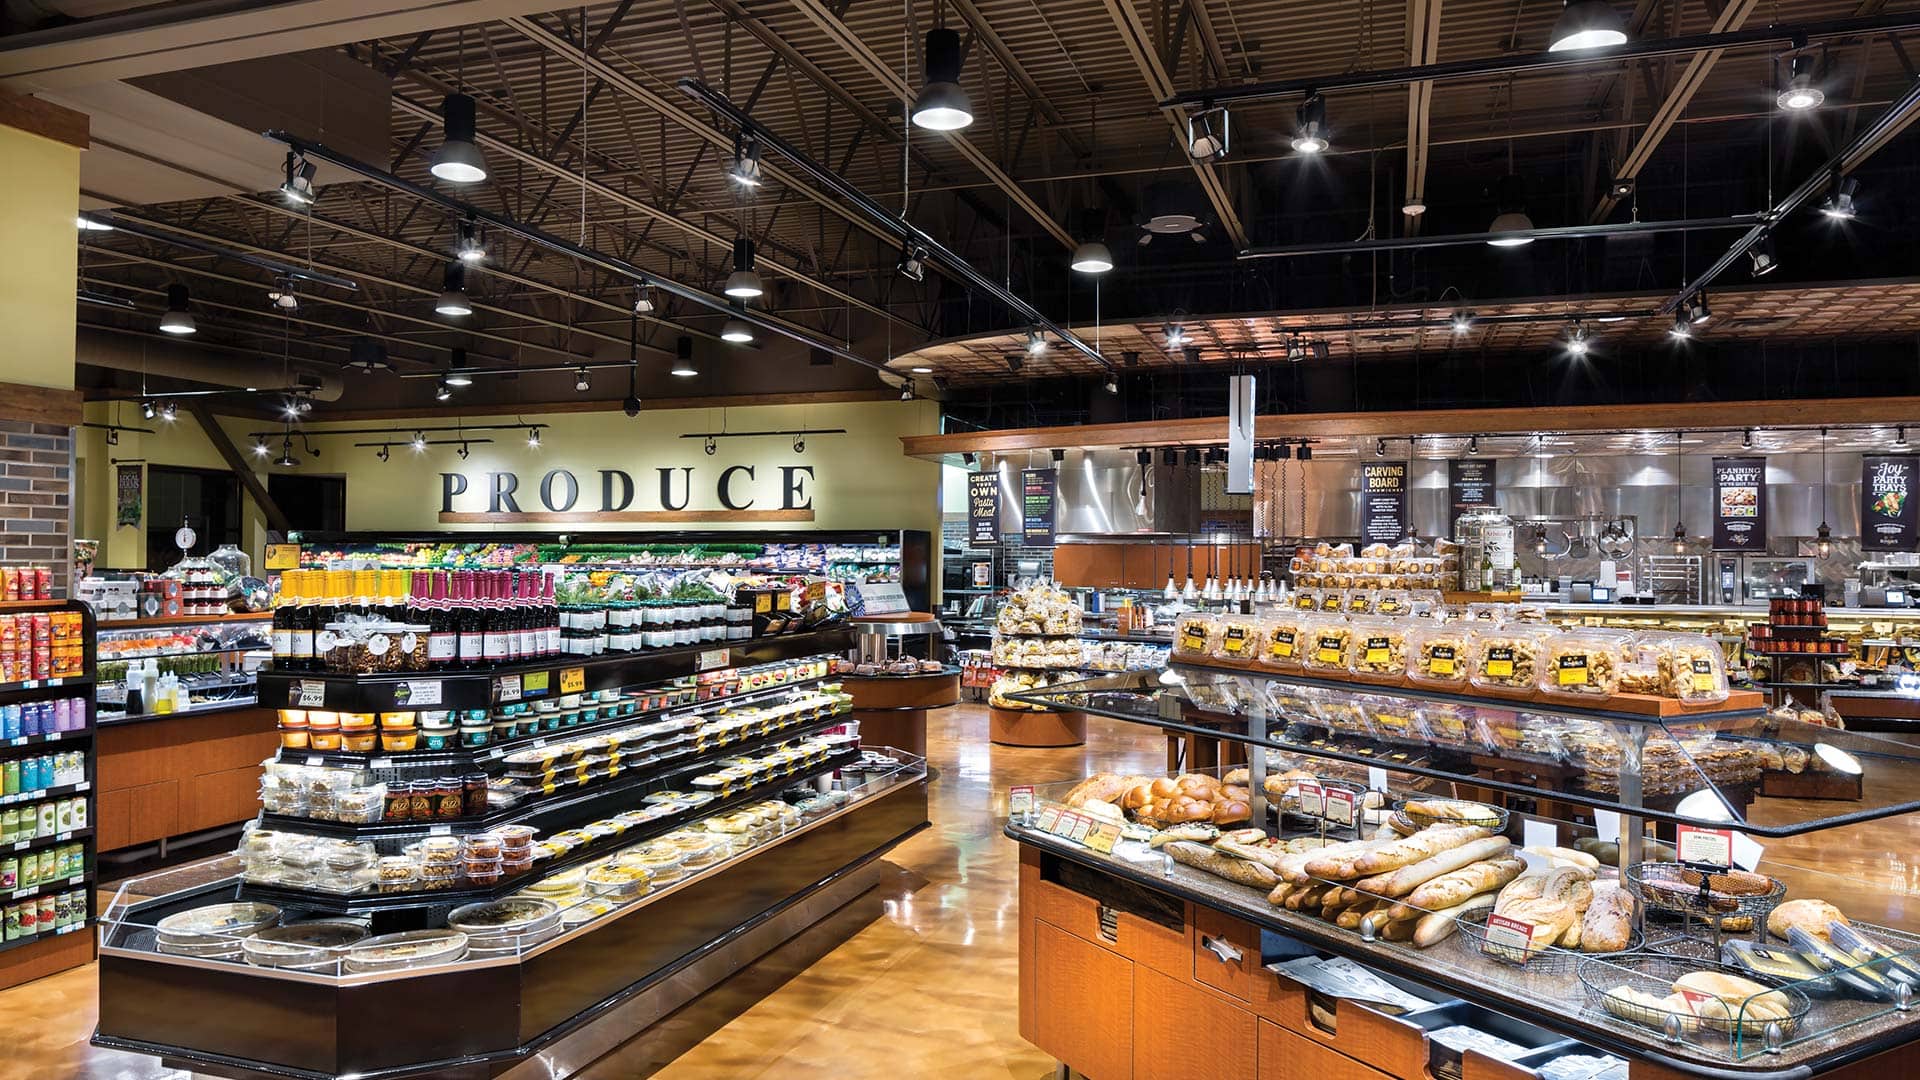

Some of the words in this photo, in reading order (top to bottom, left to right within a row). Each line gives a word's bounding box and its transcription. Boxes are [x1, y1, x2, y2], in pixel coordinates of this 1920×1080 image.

[1365, 466, 1403, 477] CARVING
[1716, 467, 1761, 475] PLANNING
[1877, 462, 1903, 477] Joy
[970, 474, 997, 482] CREATE
[1369, 477, 1399, 488] BOARD
[1720, 474, 1758, 482] PARTY
[1873, 475, 1908, 484] PARTY
[439, 465, 815, 513] PRODUCE
[971, 487, 997, 496] OWN
[1872, 483, 1908, 492] TRAYS
[973, 498, 994, 508] Pasta
[973, 507, 996, 518] Meal
[303, 694, 323, 702] $6.99
